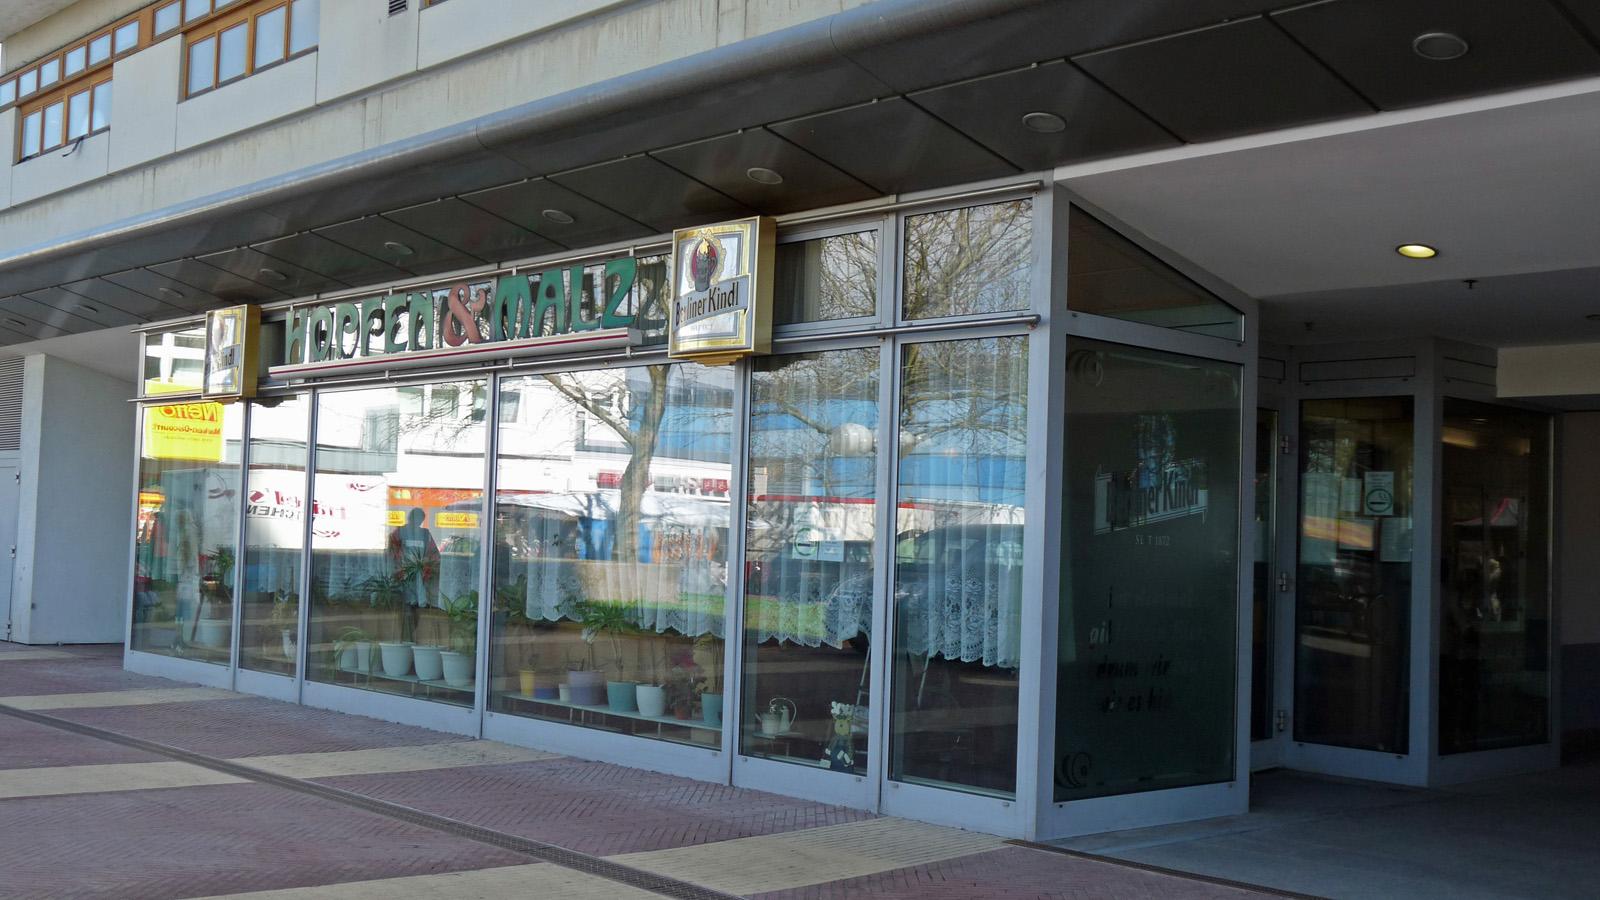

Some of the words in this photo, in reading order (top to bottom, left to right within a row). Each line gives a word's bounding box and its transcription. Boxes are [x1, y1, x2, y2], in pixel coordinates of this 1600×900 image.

[285, 291, 434, 364] HOPFEN
[443, 283, 486, 347] &
[493, 256, 637, 339] MALZ
[708, 281, 739, 312] Kindl
